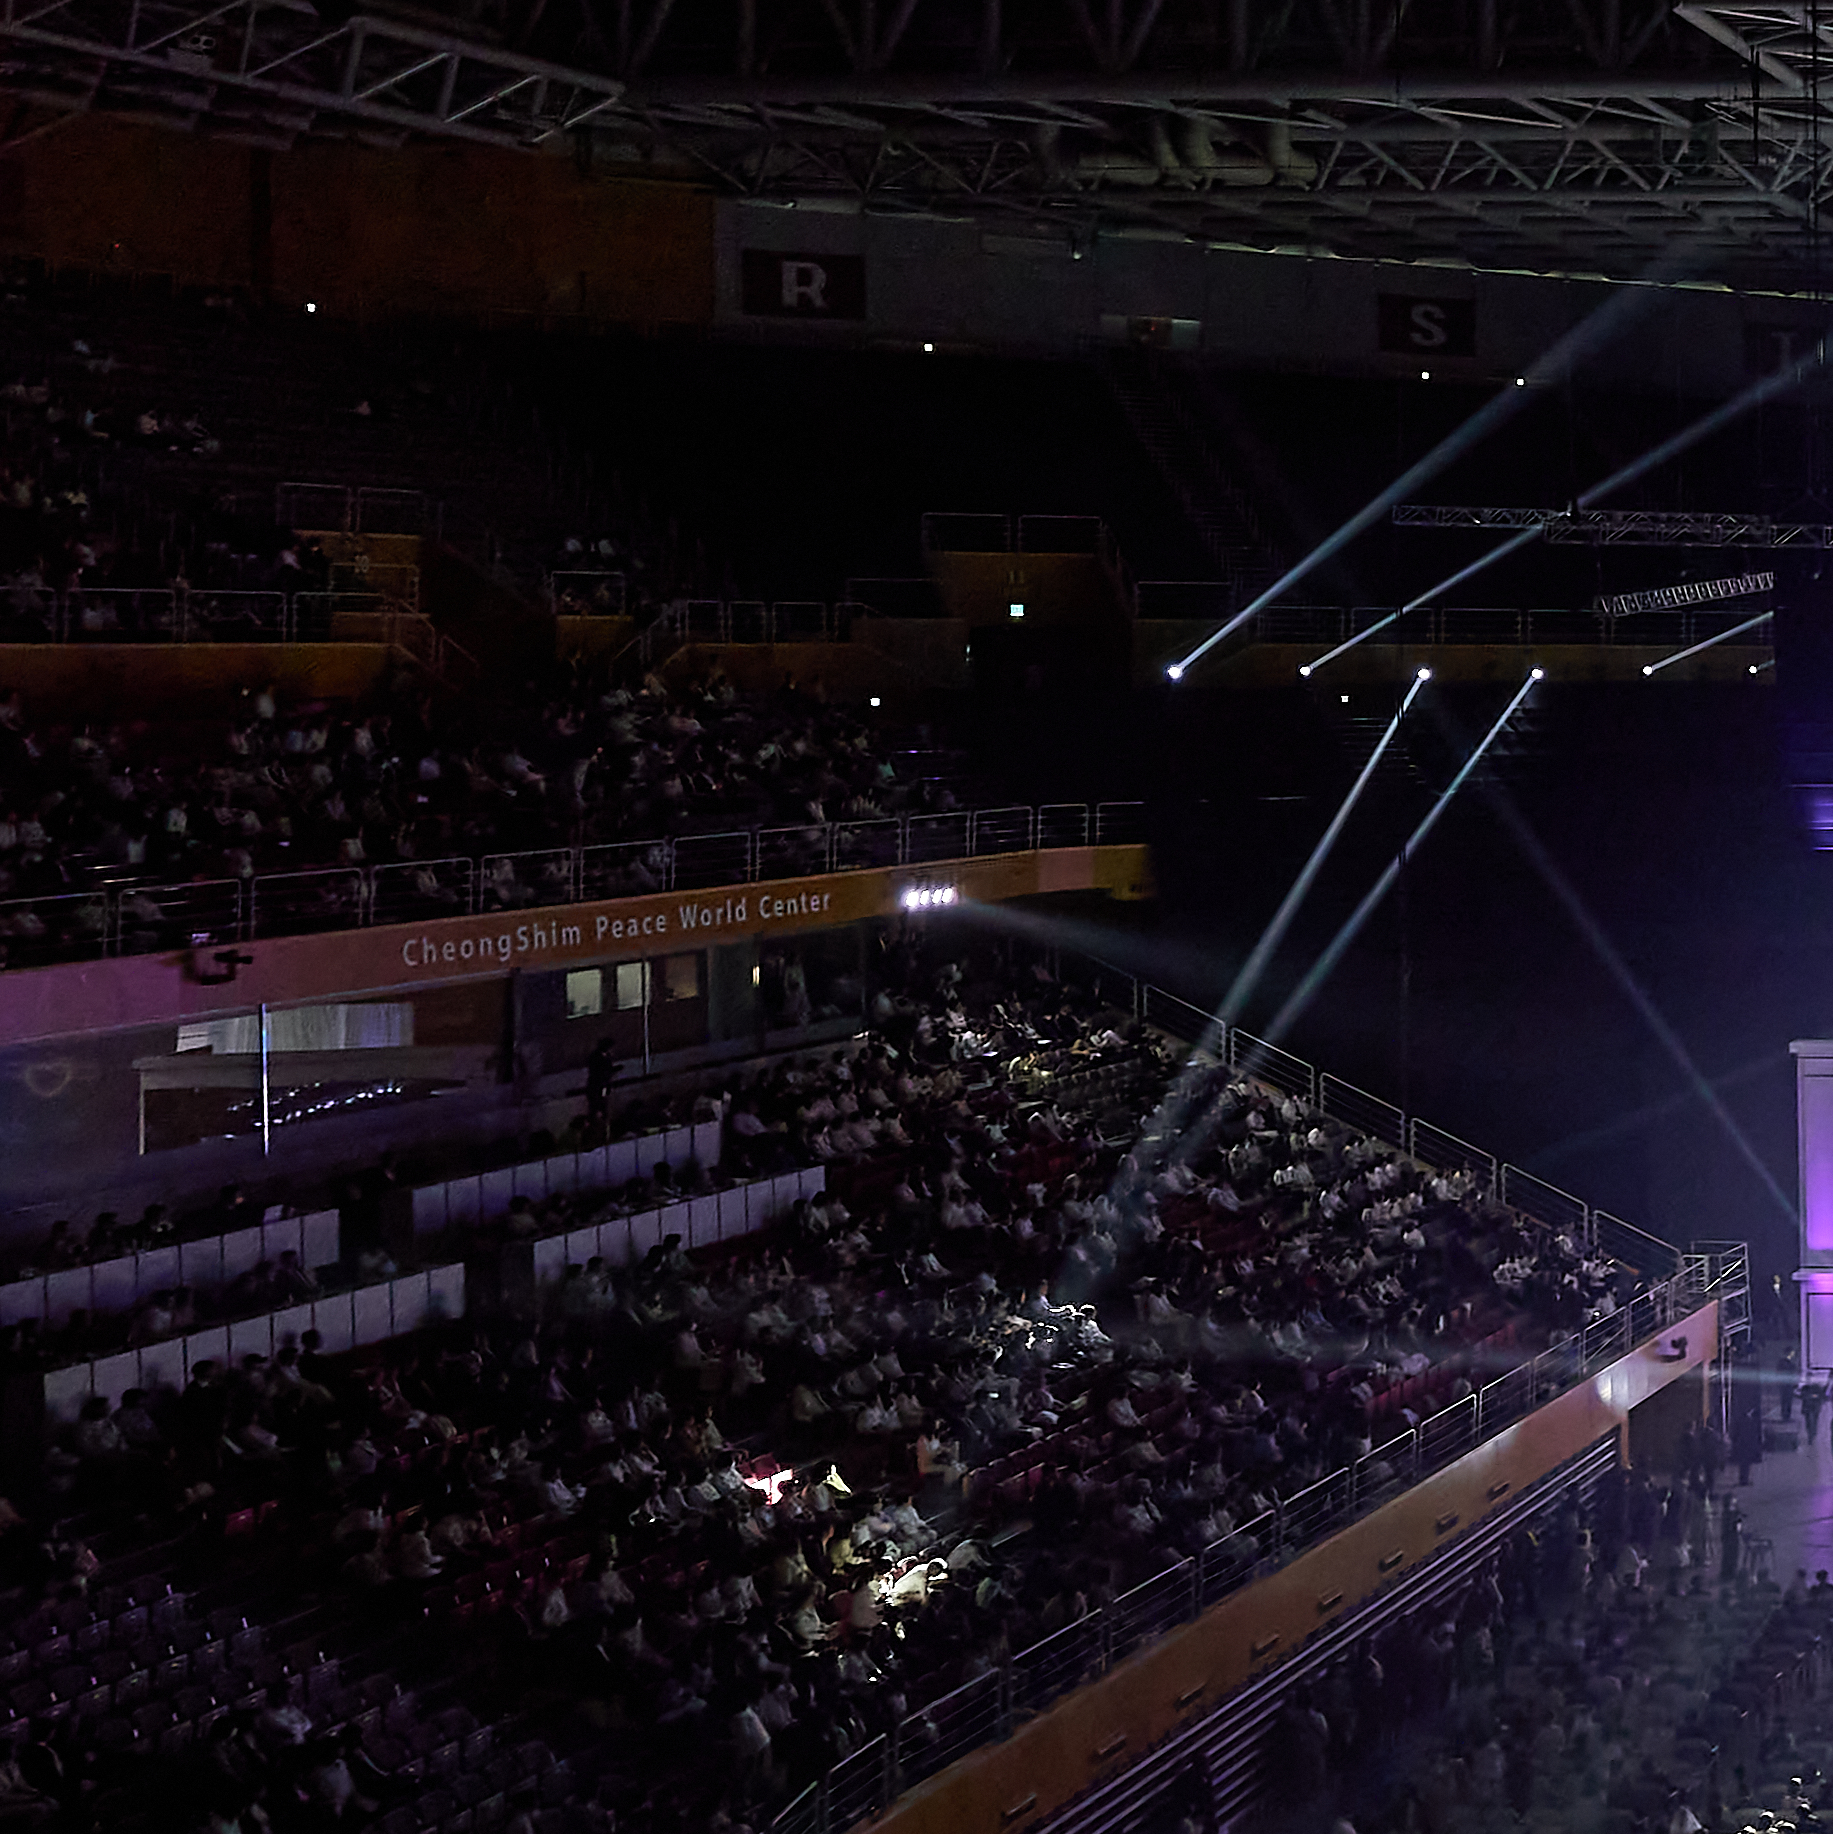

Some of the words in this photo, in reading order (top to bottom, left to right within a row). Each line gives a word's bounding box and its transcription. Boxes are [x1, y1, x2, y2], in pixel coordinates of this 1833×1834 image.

[781, 260, 828, 308] R
[1409, 303, 1447, 346] S
[402, 920, 581, 966] CheongShim
[596, 914, 667, 941] Peace
[679, 897, 747, 929] World
[759, 892, 831, 919] Center
